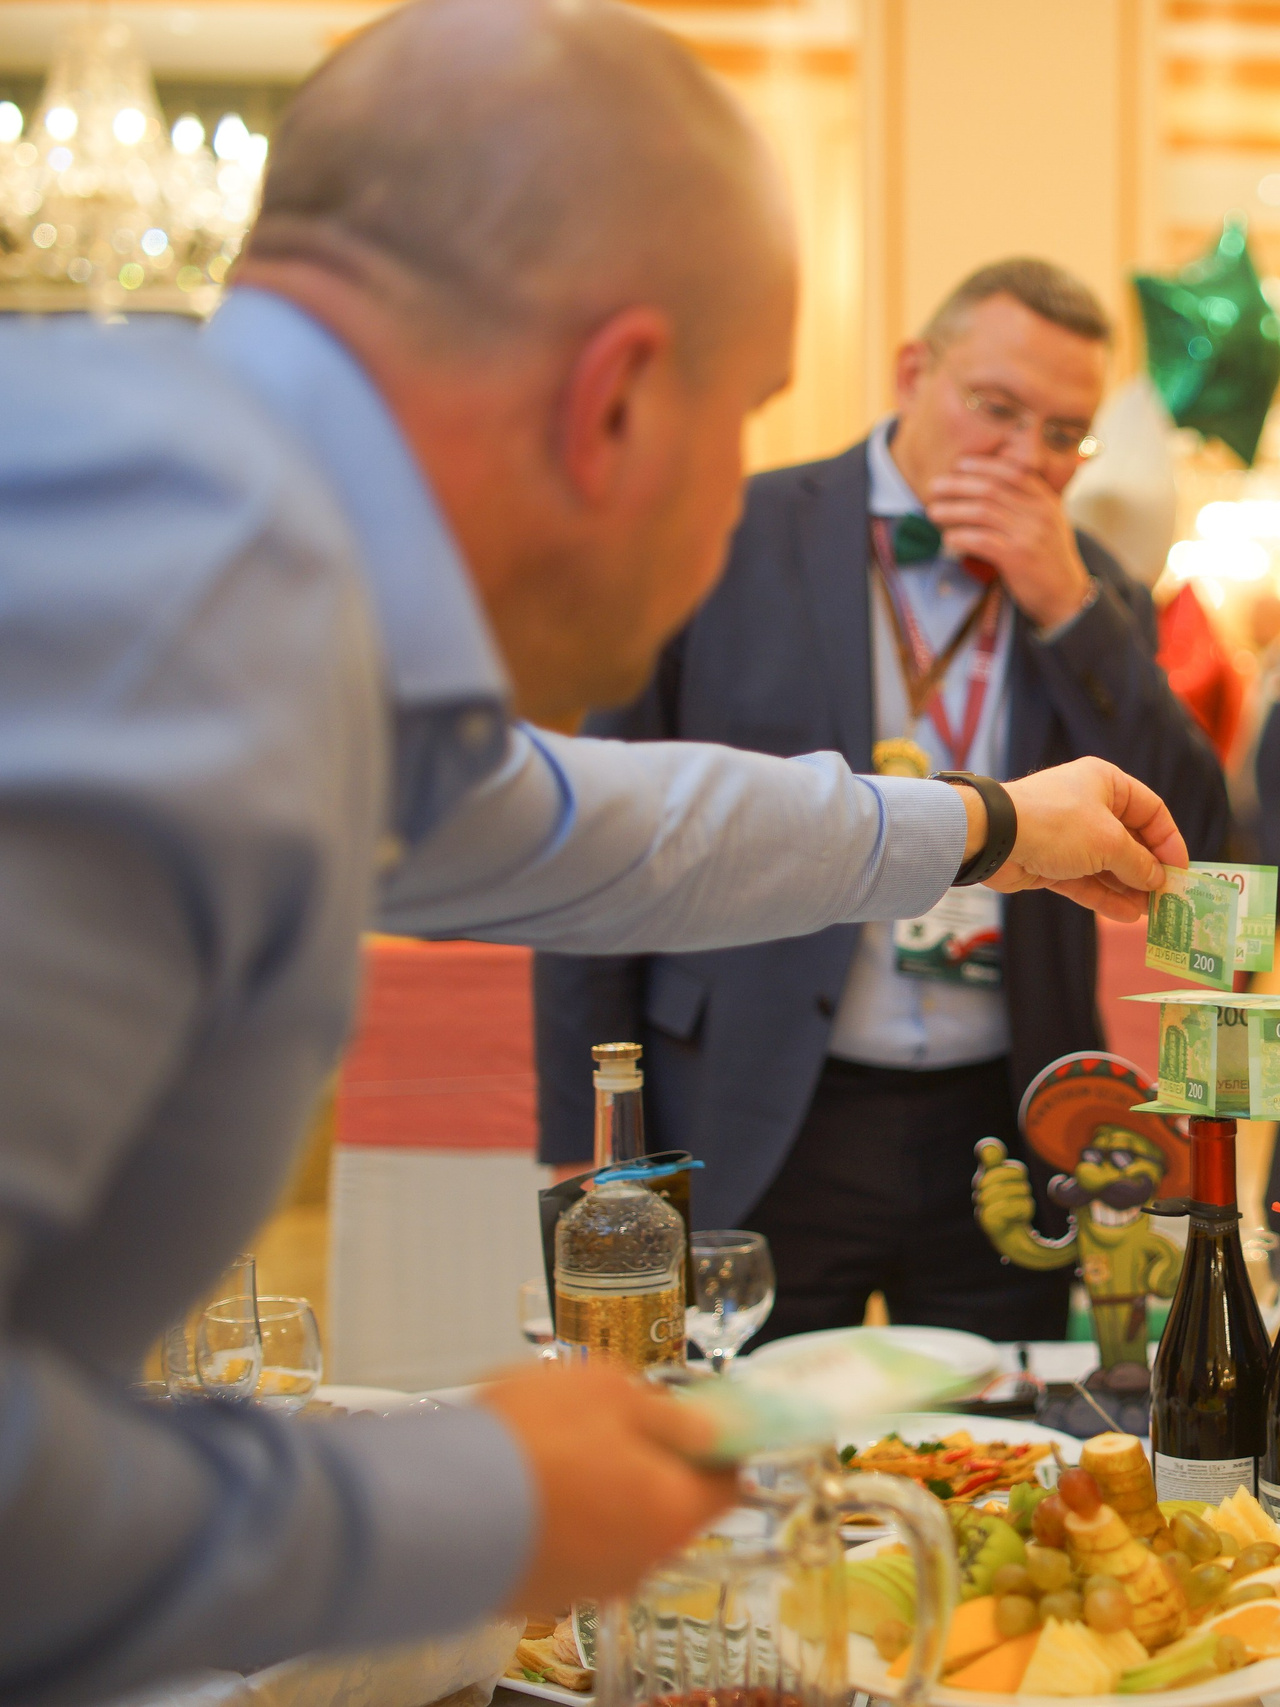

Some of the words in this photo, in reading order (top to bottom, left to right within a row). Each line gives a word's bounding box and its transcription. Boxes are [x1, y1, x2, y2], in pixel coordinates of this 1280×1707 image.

[1155, 948, 1187, 965] ДУБЛЕЙ
[1193, 954, 1215, 973] 200
[1187, 1083, 1204, 1099] 200
